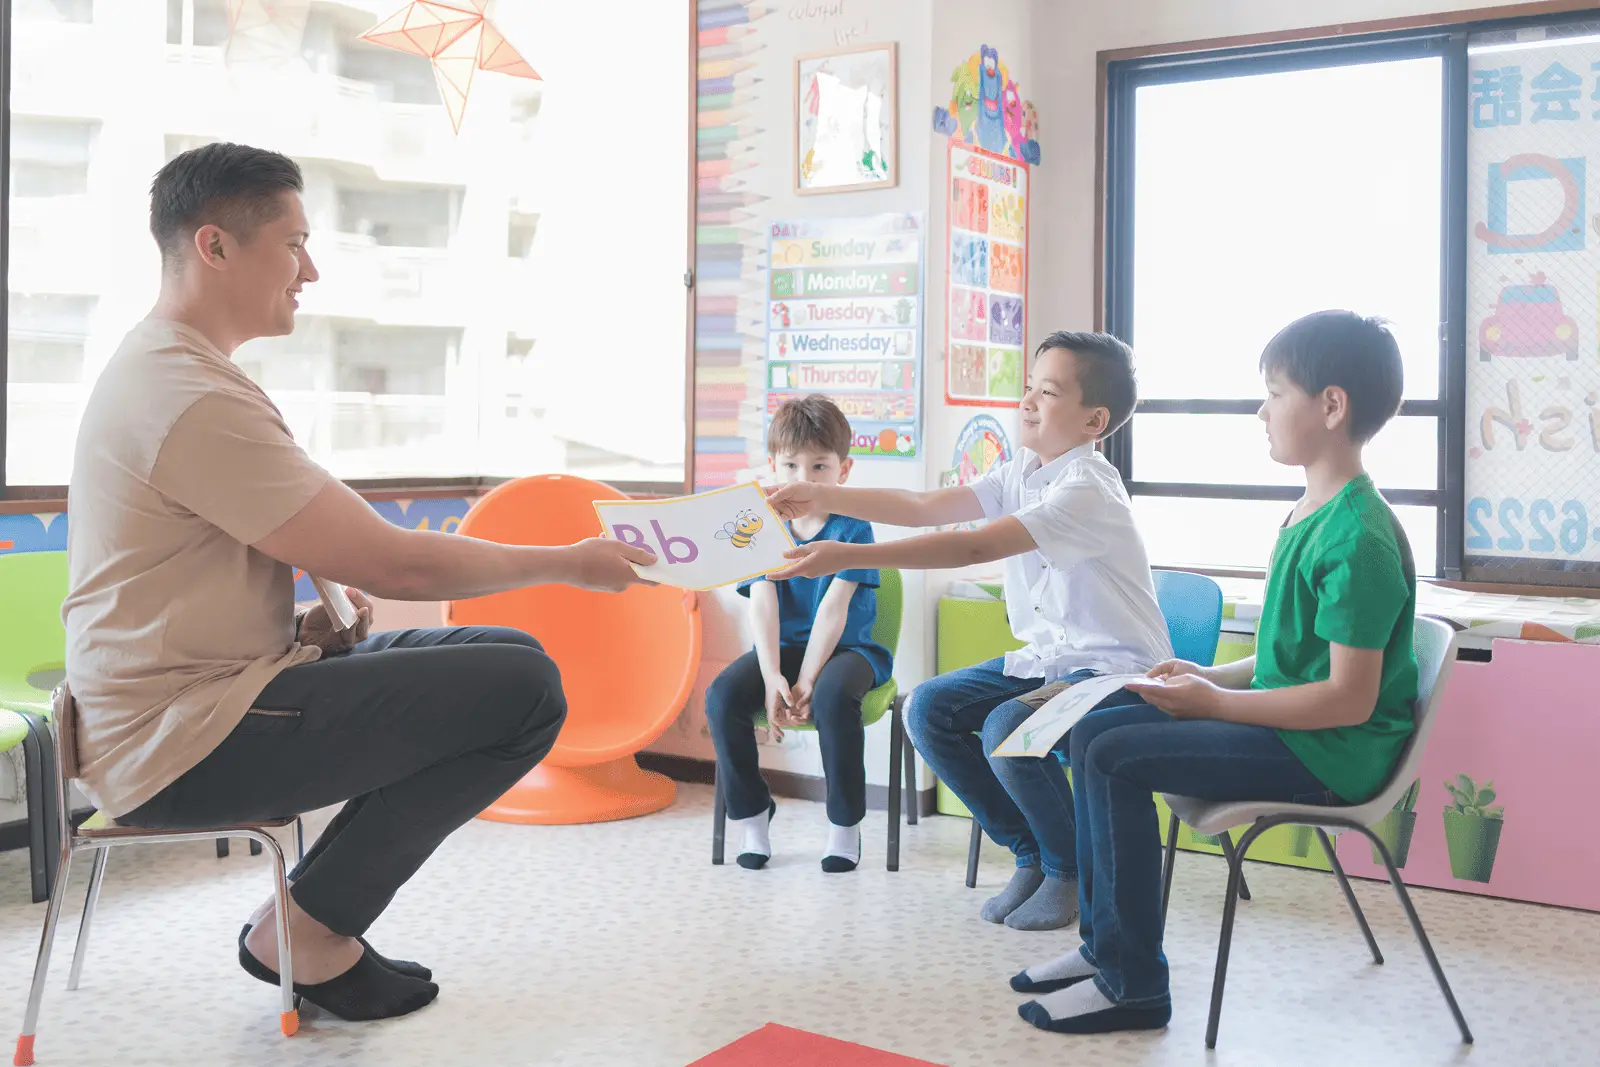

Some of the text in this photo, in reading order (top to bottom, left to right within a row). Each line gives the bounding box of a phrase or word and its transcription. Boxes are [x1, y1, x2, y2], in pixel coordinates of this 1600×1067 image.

[811, 240, 876, 260] Sunday
[806, 270, 878, 293] Monday
[807, 302, 875, 325] Tuesday
[792, 332, 891, 354] Wednesday
[801, 365, 878, 386] Thursday
[612, 519, 699, 565] Bb
